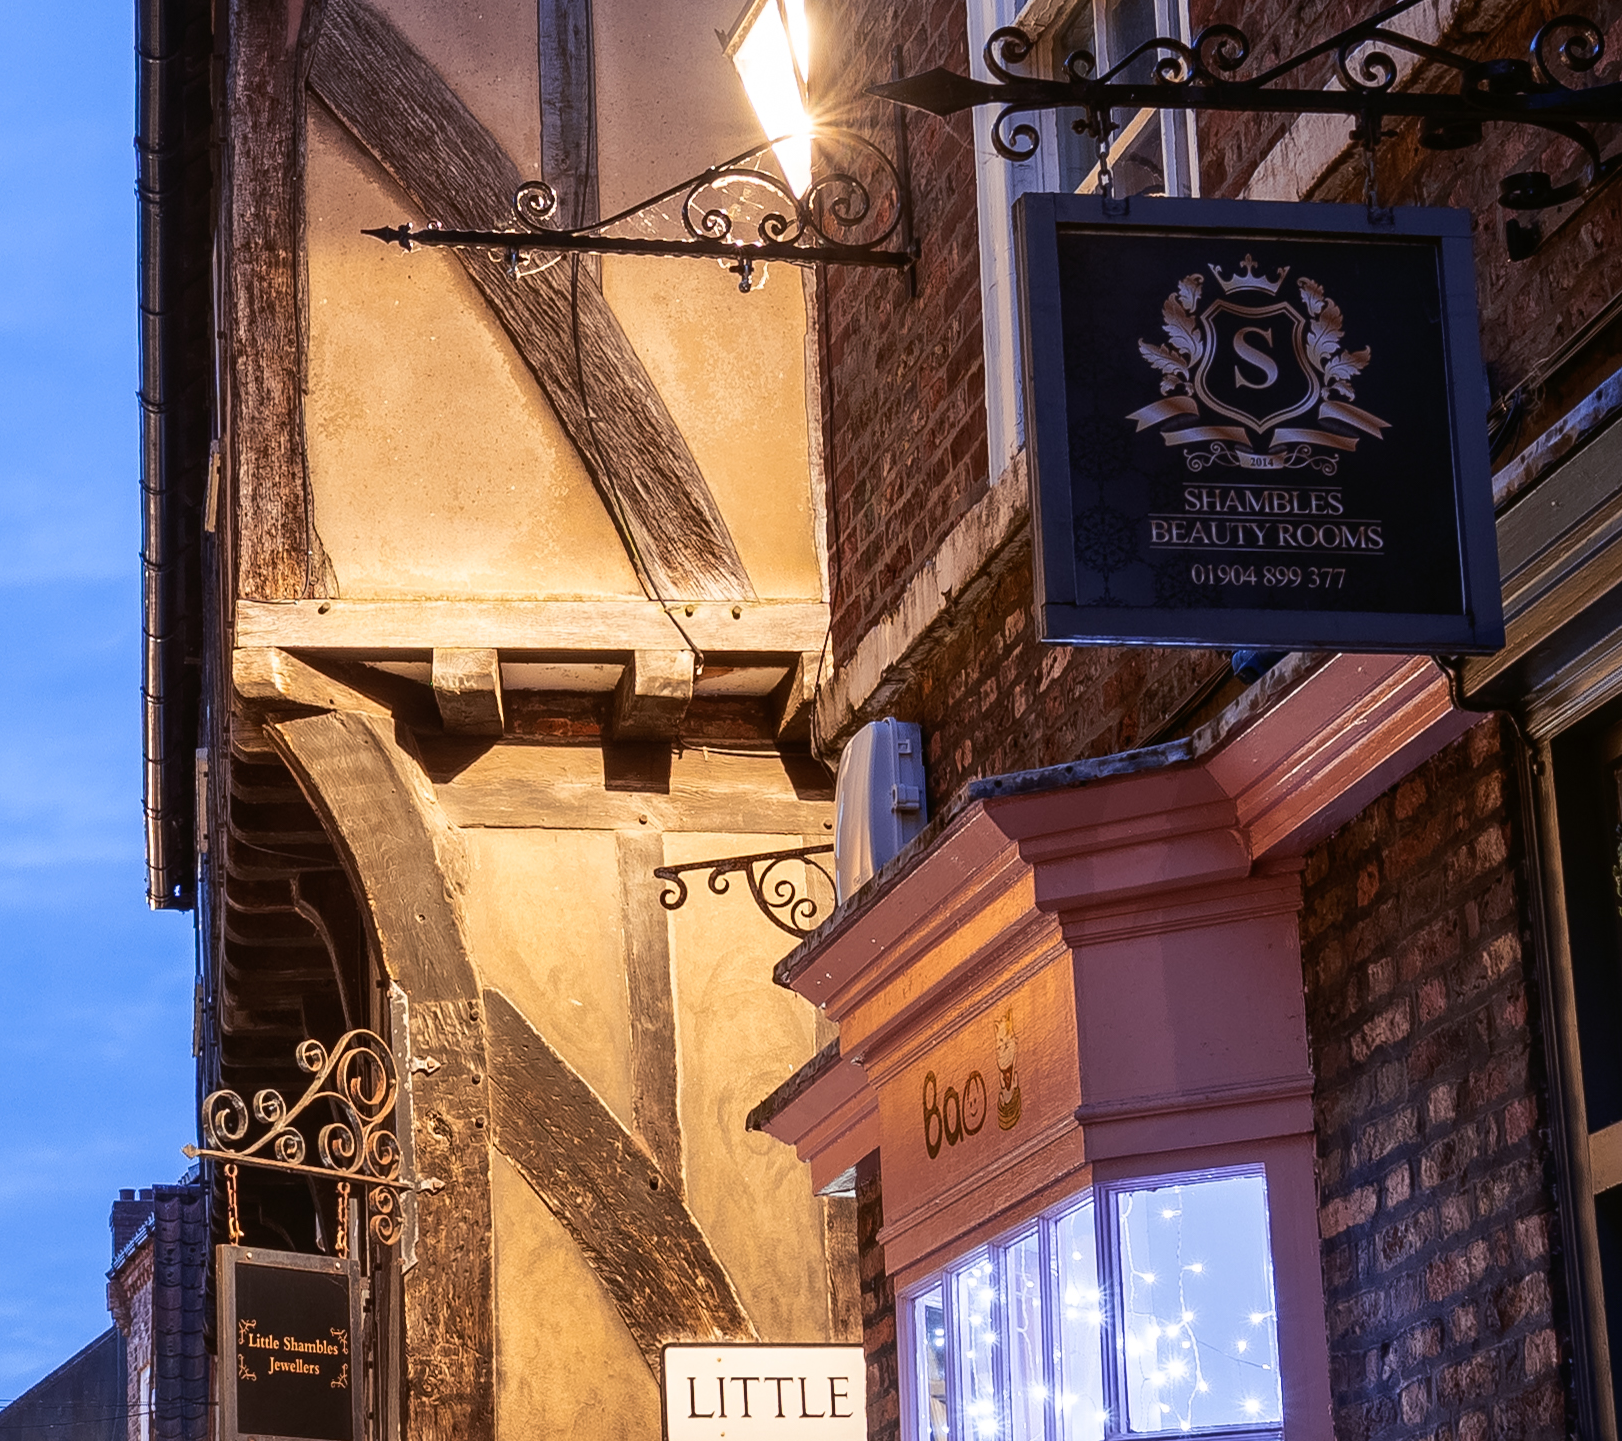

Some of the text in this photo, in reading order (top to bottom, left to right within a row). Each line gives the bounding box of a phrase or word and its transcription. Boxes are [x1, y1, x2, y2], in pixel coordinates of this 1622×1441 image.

[1233, 326, 1280, 390] S
[1249, 455, 1275, 468] 2014
[1184, 487, 1344, 516] SHAMBLES
[1150, 518, 1384, 550] BEAUTY ROOMS
[1190, 562, 1347, 590] 01904 899 377
[920, 1070, 987, 1160] Bao
[248, 1332, 339, 1356] Little Shambles
[268, 1357, 321, 1376] Jewellers
[686, 1375, 854, 1420] LITTLE
